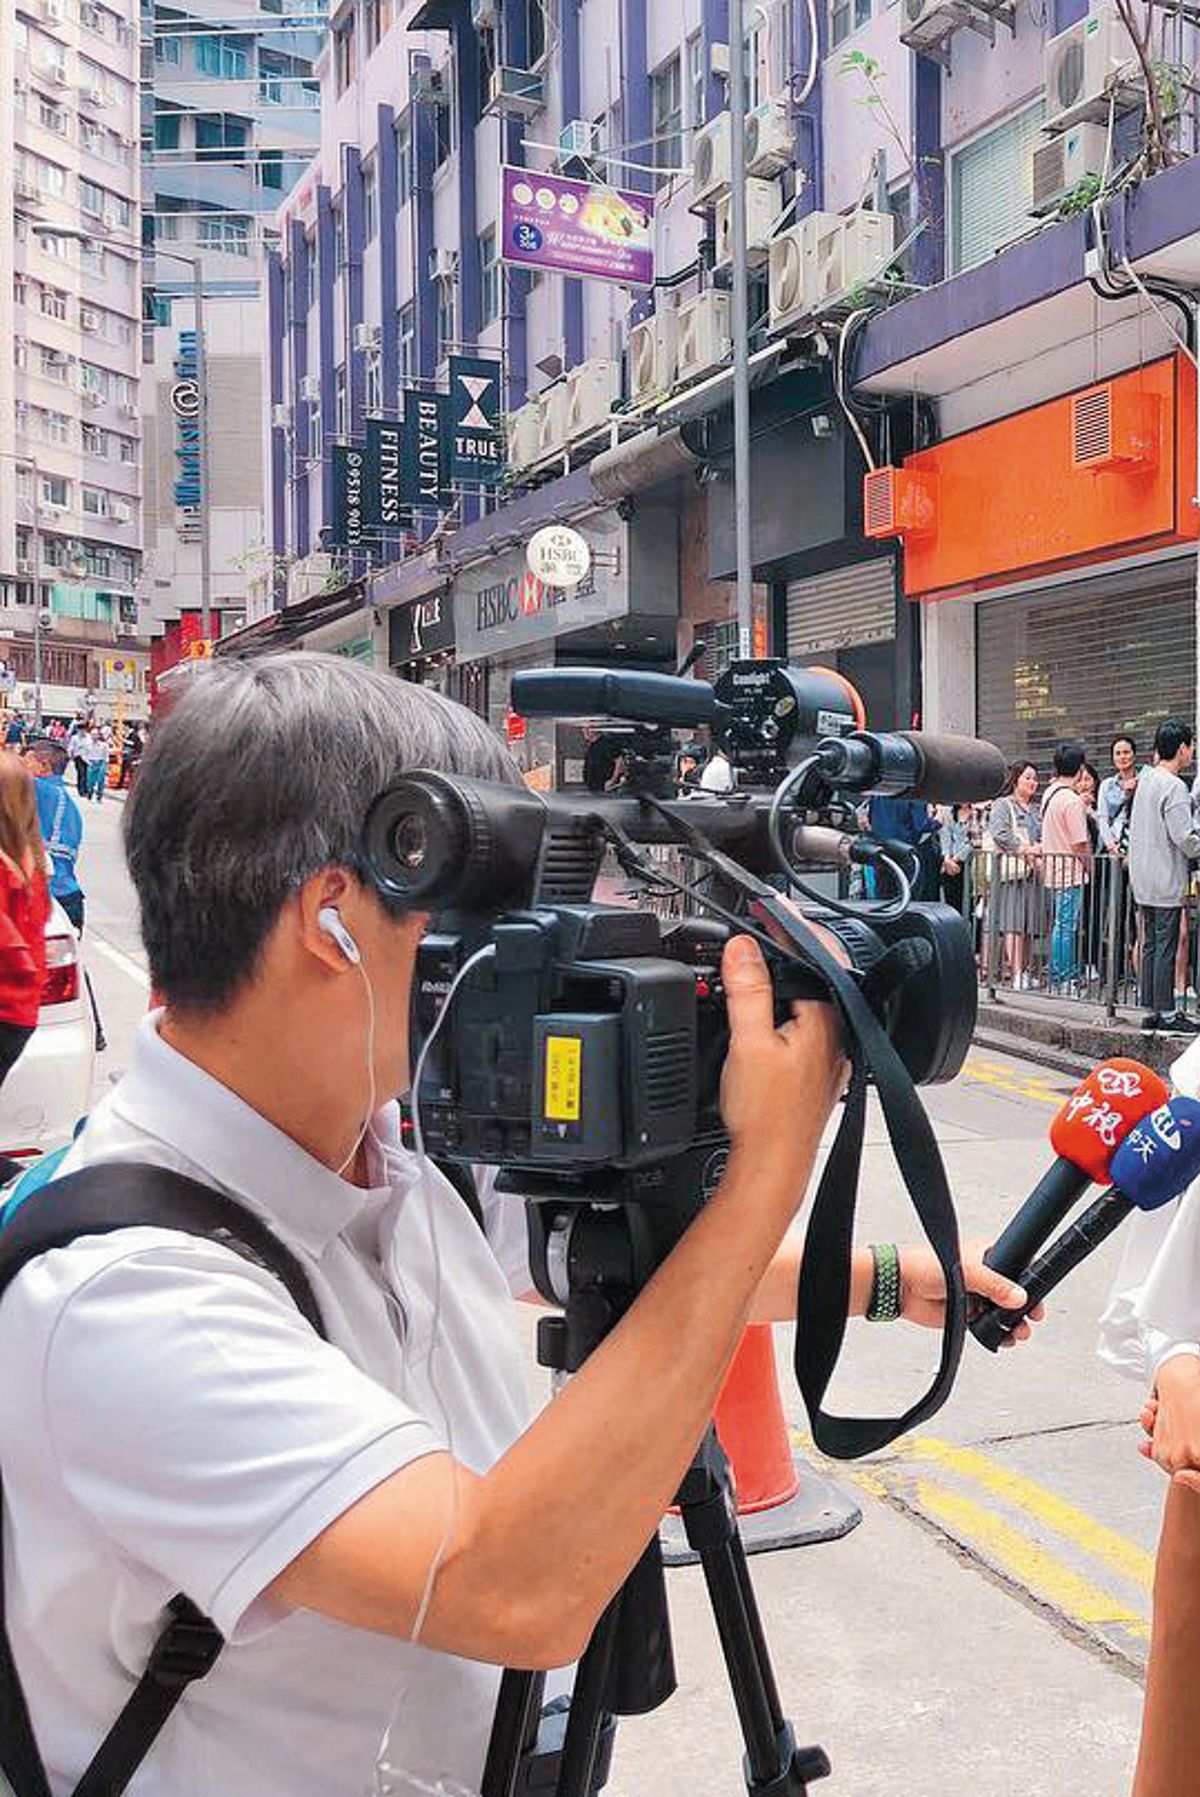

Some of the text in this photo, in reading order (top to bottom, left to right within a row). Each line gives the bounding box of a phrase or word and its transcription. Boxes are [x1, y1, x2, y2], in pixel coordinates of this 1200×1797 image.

[418, 401, 439, 499] BEAUTY
[455, 437, 498, 458] TRUE
[379, 429, 399, 523] FITNESS
[539, 547, 582, 562] HSBC
[477, 577, 519, 632] HSBC
